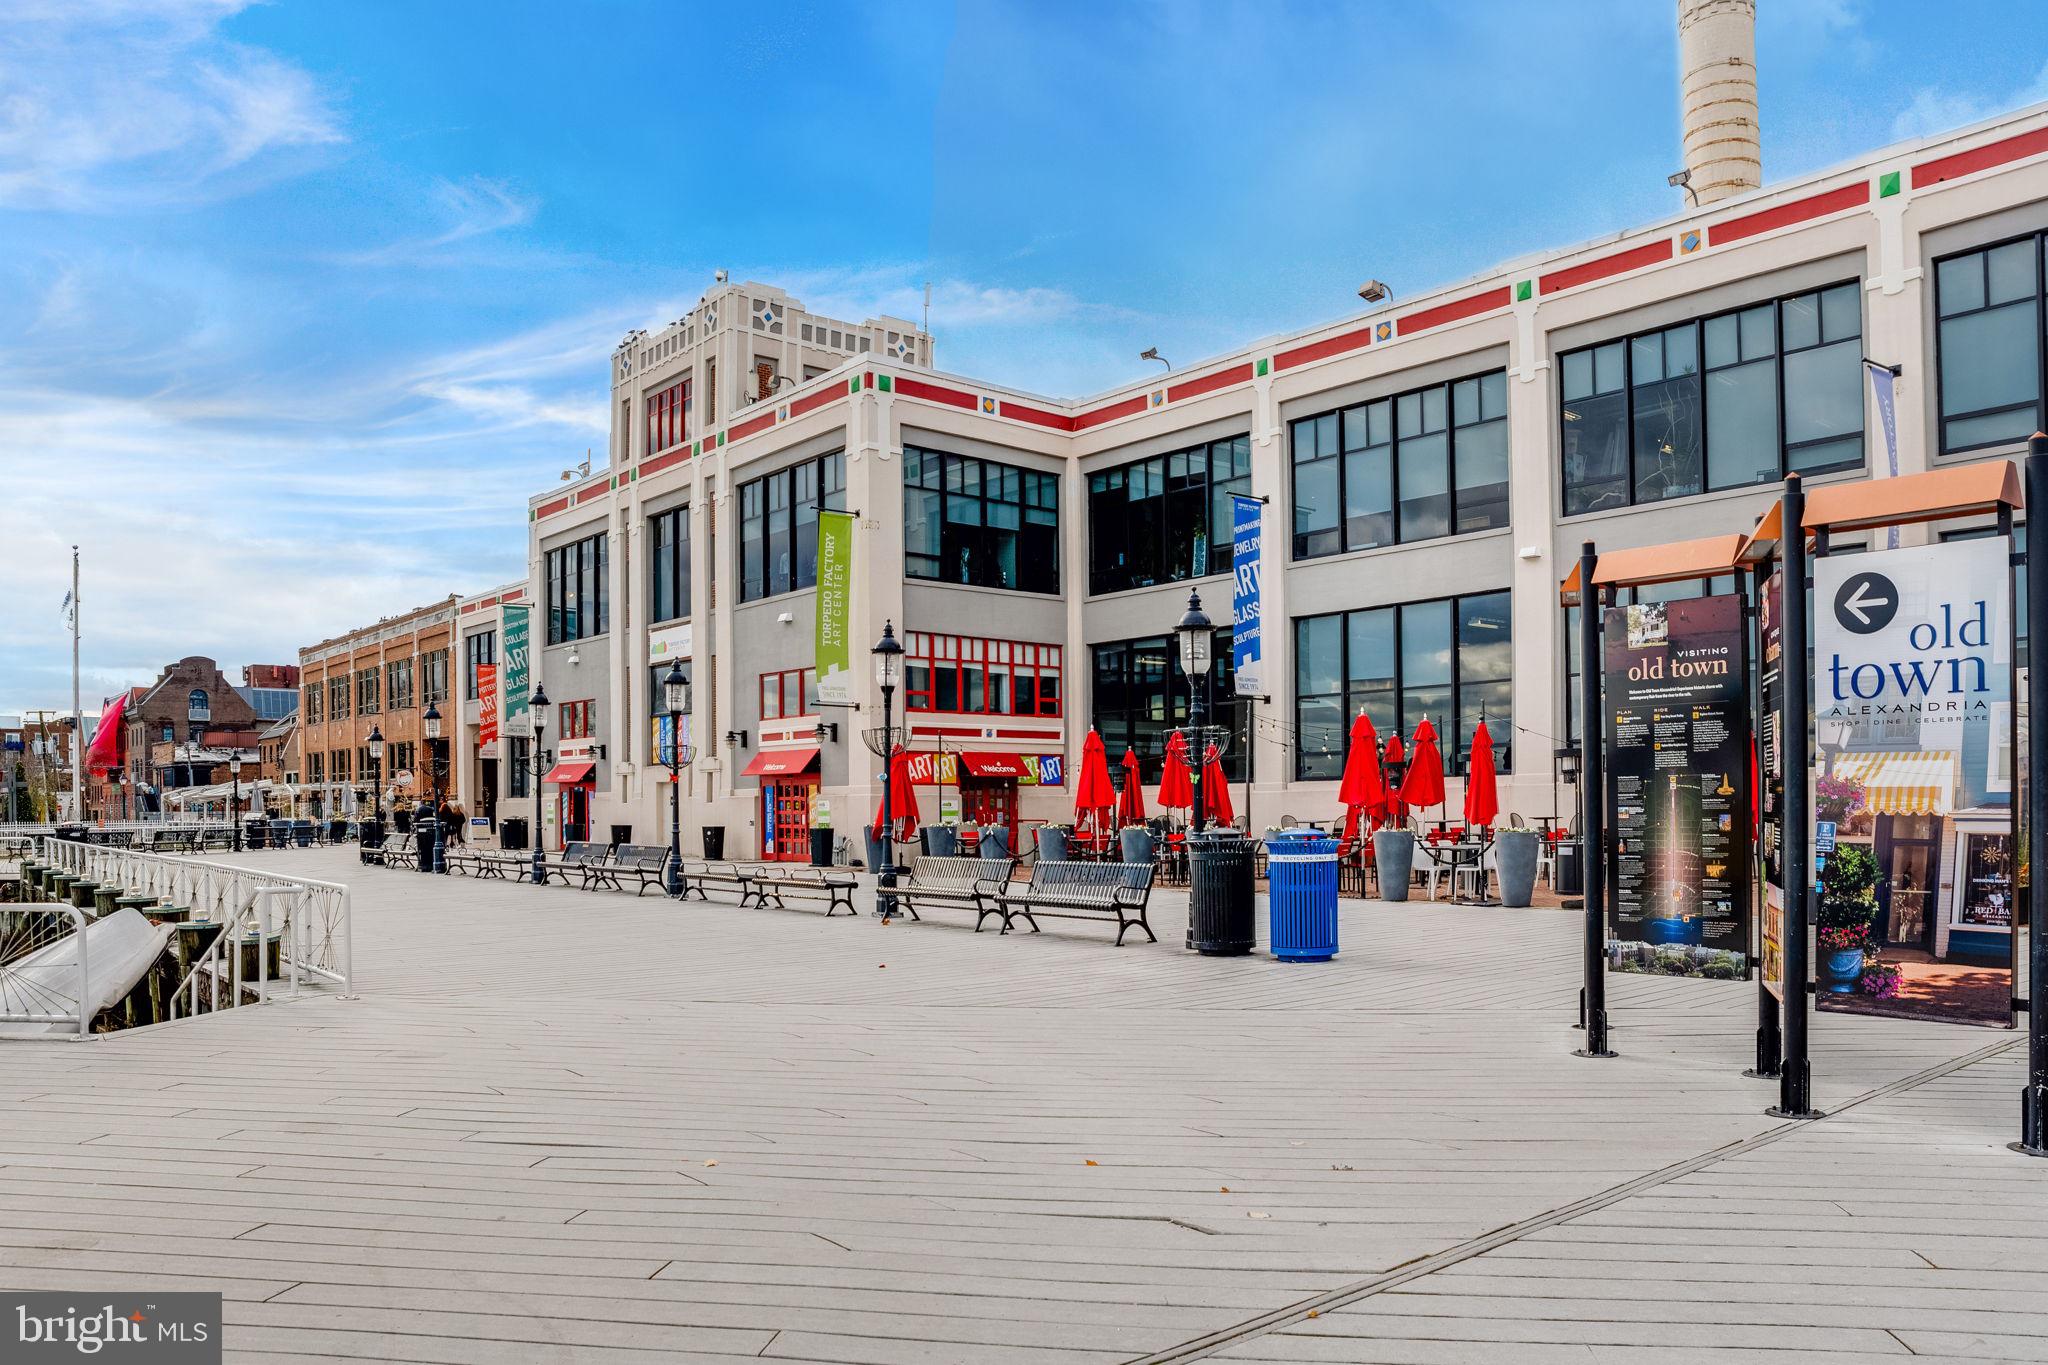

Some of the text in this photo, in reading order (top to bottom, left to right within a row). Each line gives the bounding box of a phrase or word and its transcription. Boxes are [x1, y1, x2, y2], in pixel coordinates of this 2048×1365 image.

[822, 532, 835, 647] TORPEDO FACTORY
[1233, 559, 1261, 600] ART
[833, 563, 844, 647] ART CENTER
[1233, 601, 1260, 626] GLASS
[1233, 626, 1261, 646] SCULPTURE
[1909, 600, 1990, 651] old
[505, 645, 529, 674] ART
[1677, 647, 1728, 657] VISITING
[506, 673, 528, 690] GLASS
[1628, 656, 1728, 682] old town
[1828, 654, 1990, 701] town
[480, 693, 497, 714] ART
[1830, 700, 1988, 717] ALEXANDRIA
[480, 713, 497, 727] GLASS
[1830, 715, 1988, 728] SHOP DINE CELEBRATE
[907, 753, 932, 782] ART
[933, 754, 957, 783] ART
[980, 764, 1017, 773] Welcome
[1040, 756, 1061, 783] ART
[1974, 906, 1993, 915] RED
